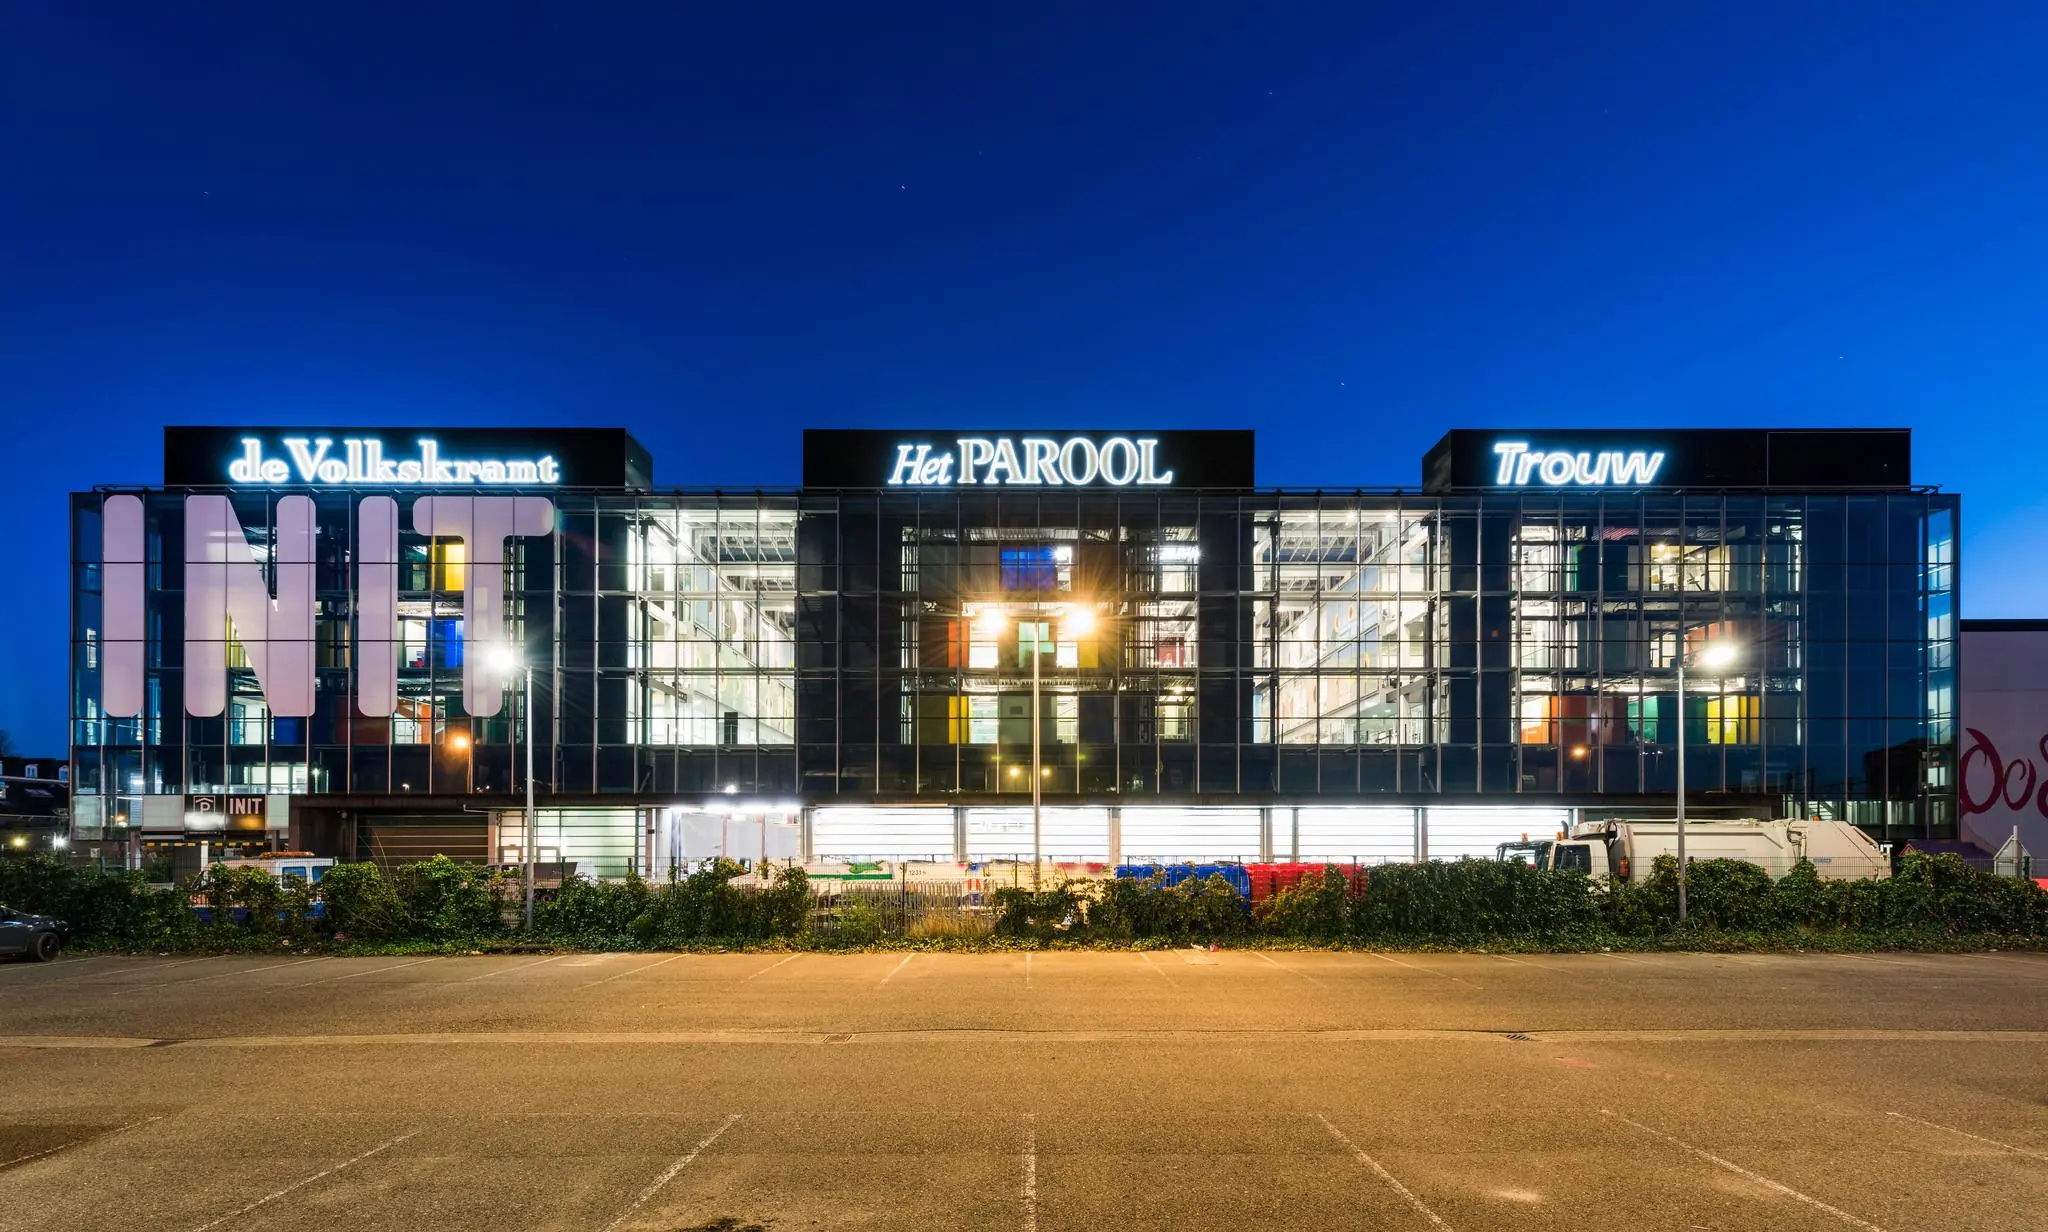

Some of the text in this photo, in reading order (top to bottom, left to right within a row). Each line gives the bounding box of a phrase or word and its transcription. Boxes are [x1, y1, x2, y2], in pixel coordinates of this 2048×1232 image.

[229, 438, 560, 483] de Volkskrant
[888, 437, 1173, 486] Het PAROOL
[1493, 443, 1665, 485] Trouw
[103, 495, 554, 718] INIT
[230, 798, 262, 814] INIT
